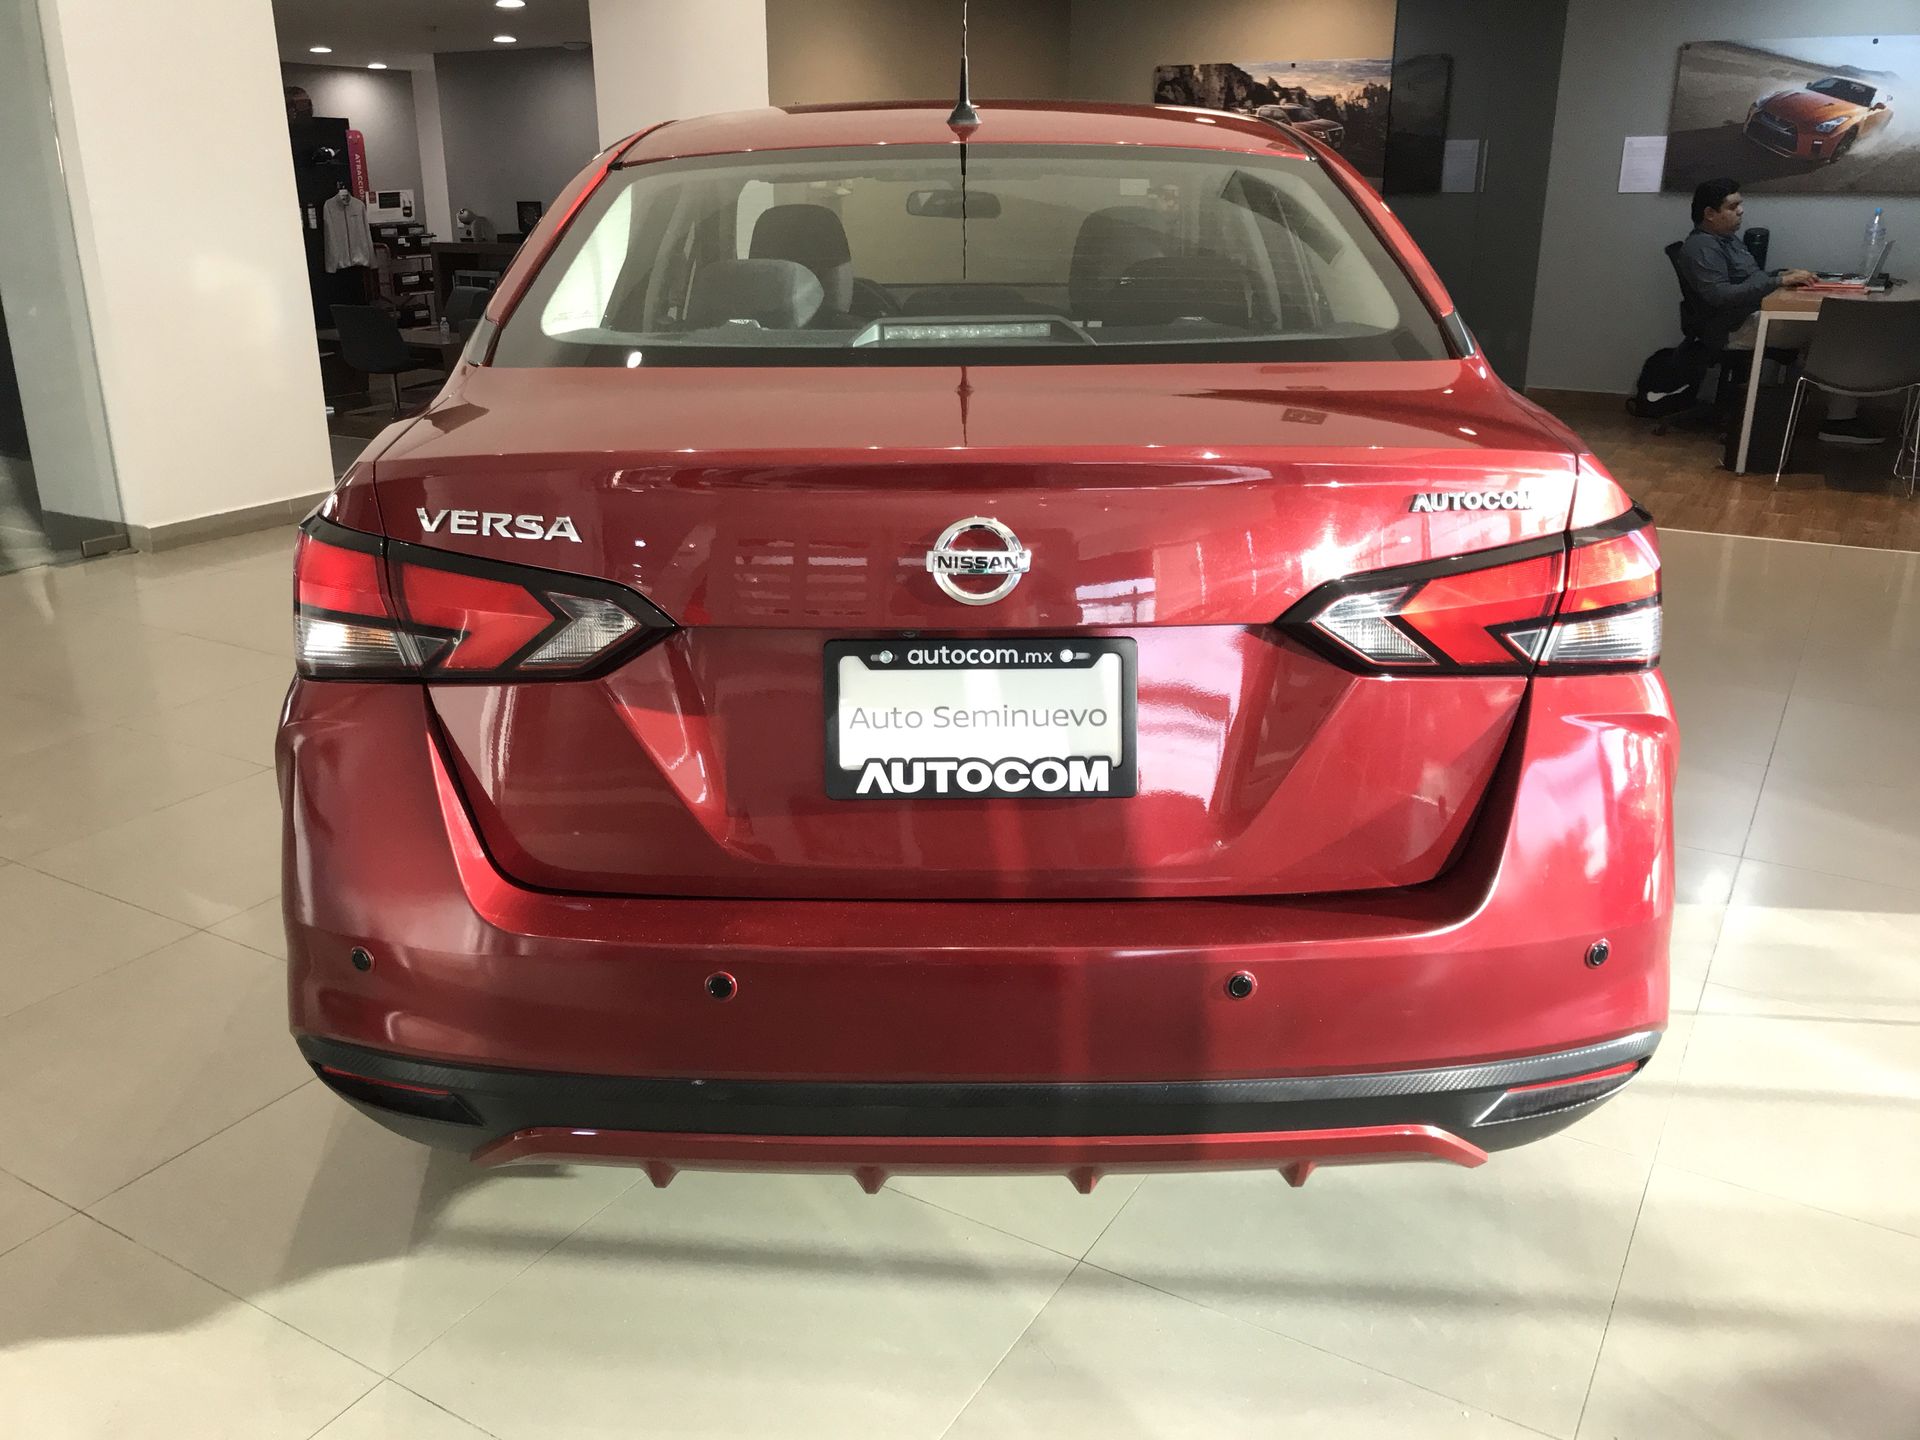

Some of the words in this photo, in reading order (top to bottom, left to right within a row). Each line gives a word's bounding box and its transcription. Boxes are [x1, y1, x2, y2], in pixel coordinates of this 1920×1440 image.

[416, 507, 583, 543] VERSA
[937, 555, 1018, 569] NISSAN
[907, 646, 1053, 665] autocom.mx
[849, 706, 923, 729] Auto
[933, 704, 1107, 728] Seminuevo
[856, 760, 1109, 794] AUTOCOM
